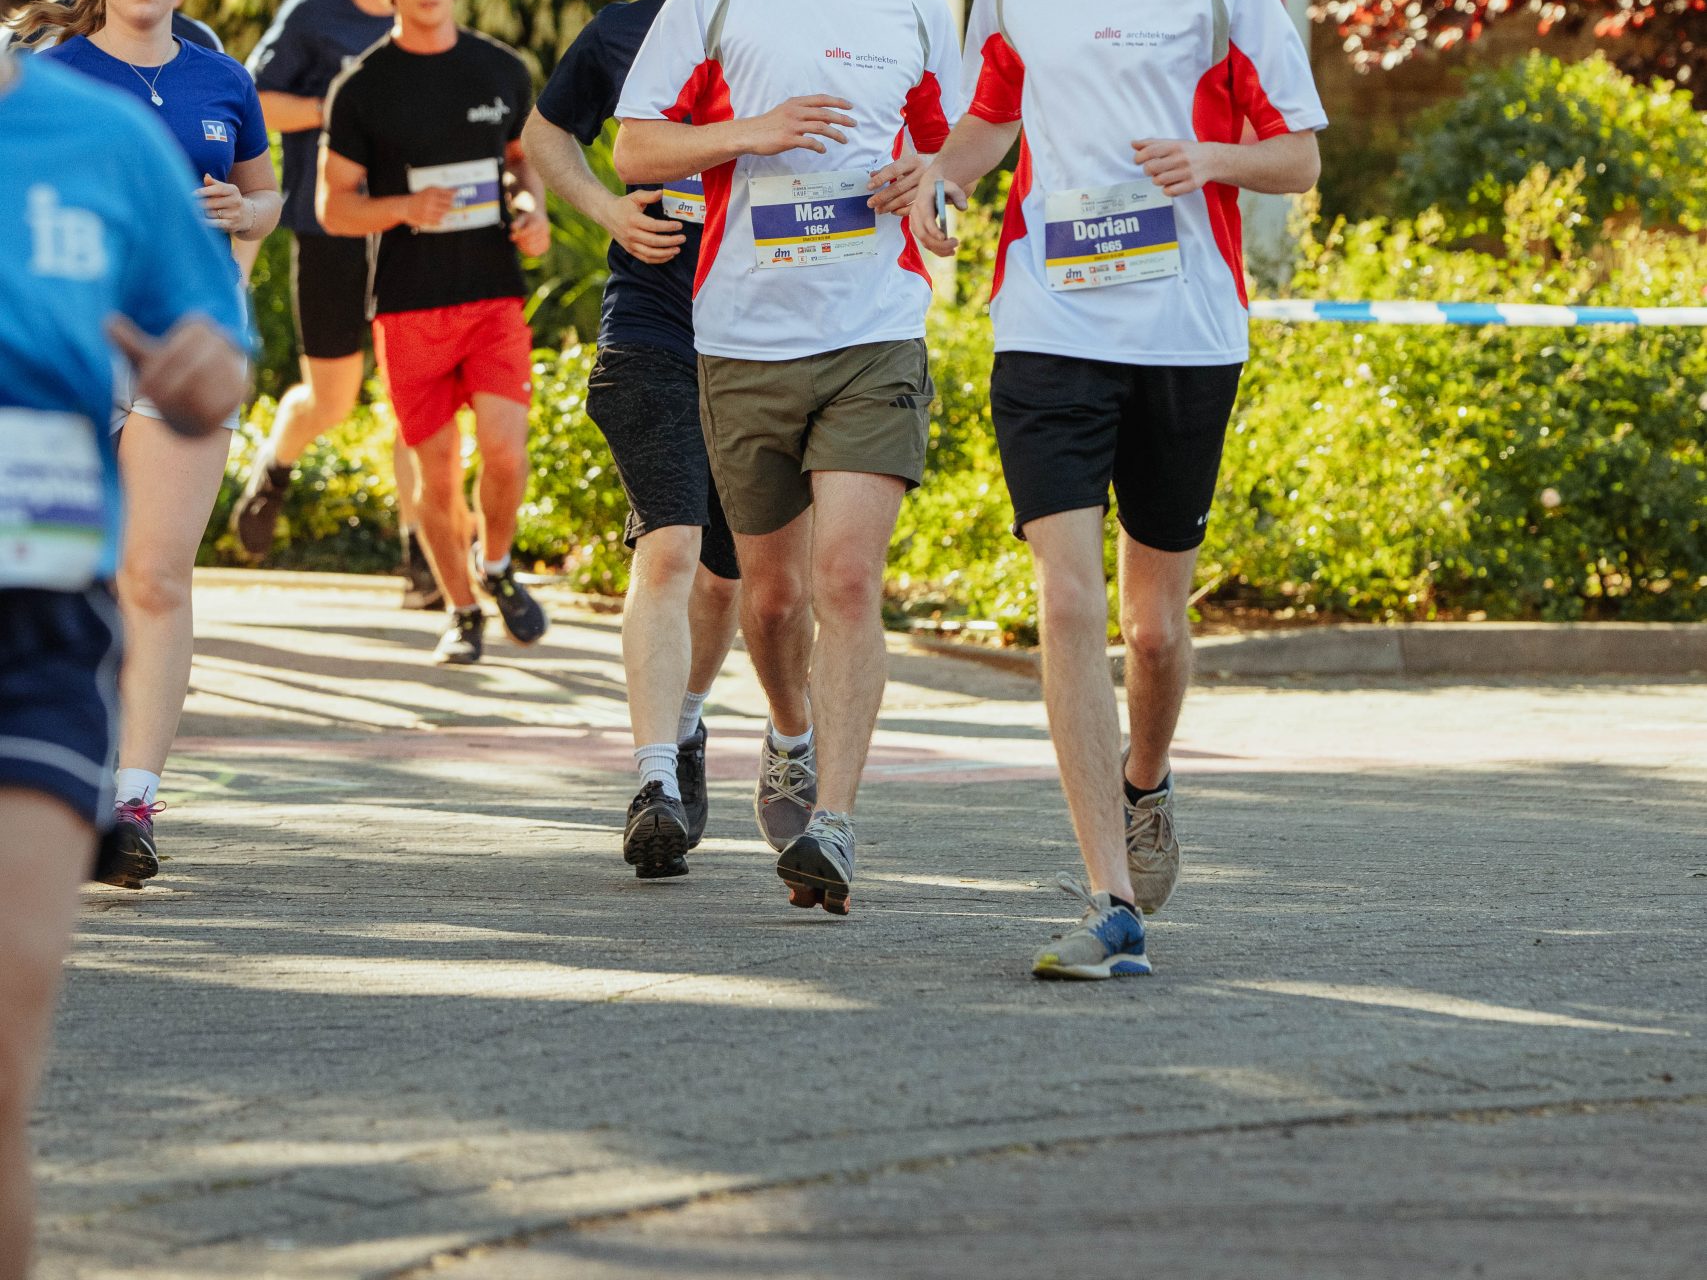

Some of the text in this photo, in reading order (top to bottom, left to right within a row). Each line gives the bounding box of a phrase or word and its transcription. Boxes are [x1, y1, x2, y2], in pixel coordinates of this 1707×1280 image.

[855, 53, 898, 65] architekten
[678, 202, 693, 212] dm
[795, 203, 835, 222] Max
[804, 224, 830, 236] 1664
[1072, 216, 1140, 241] Dorian
[1094, 239, 1123, 254] 1665
[774, 248, 791, 259] dm
[1065, 268, 1082, 280] dm
